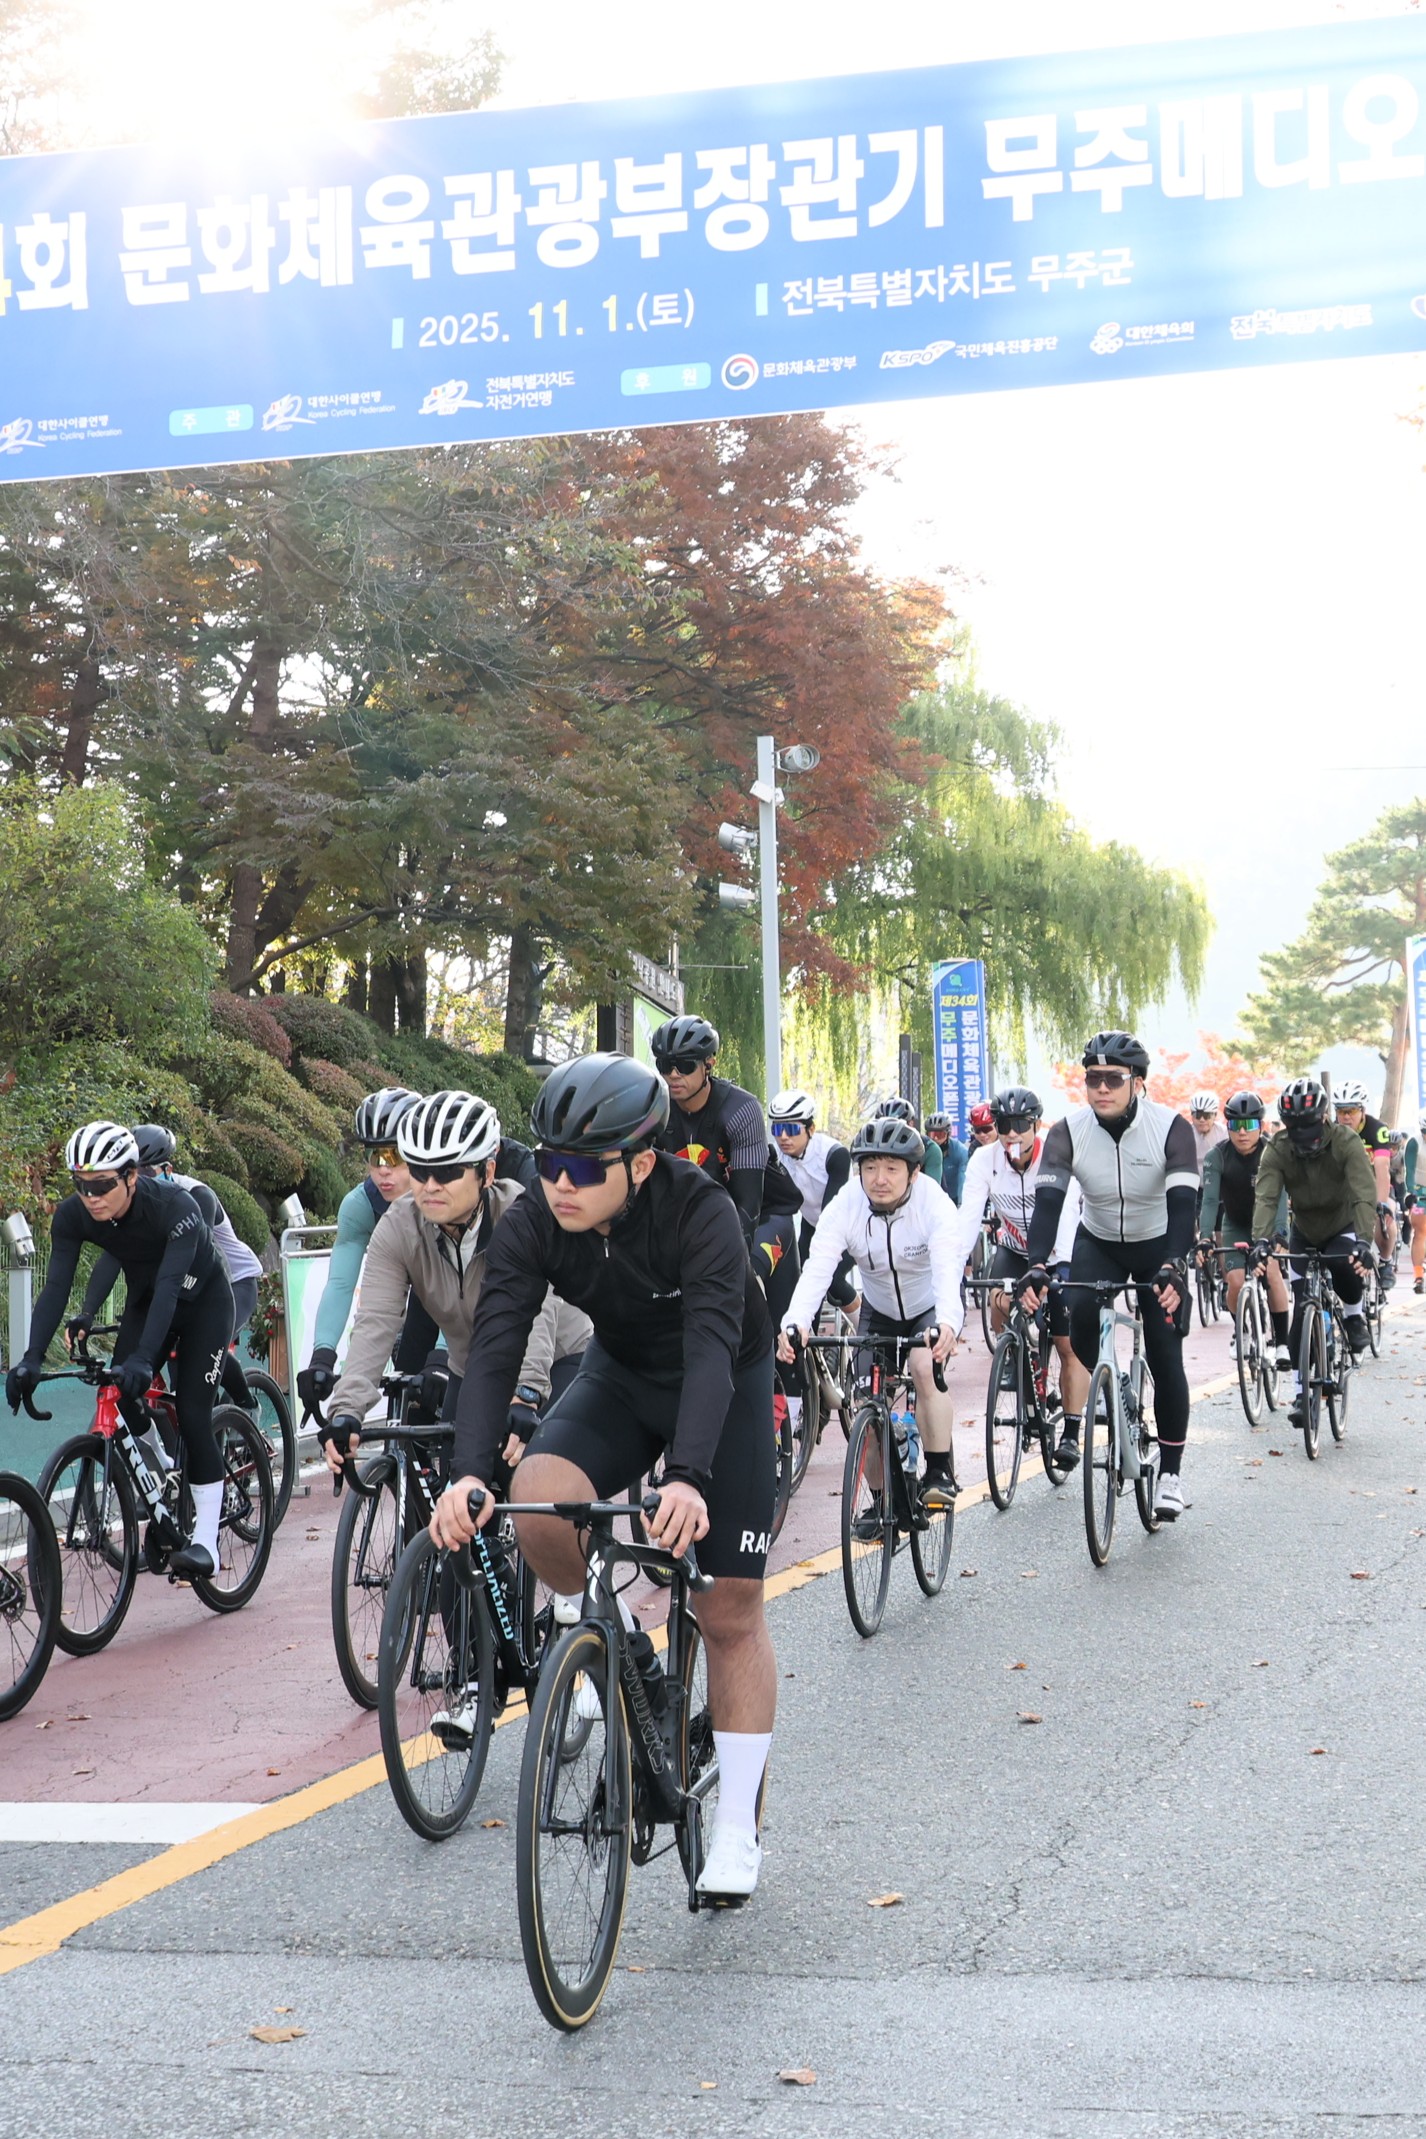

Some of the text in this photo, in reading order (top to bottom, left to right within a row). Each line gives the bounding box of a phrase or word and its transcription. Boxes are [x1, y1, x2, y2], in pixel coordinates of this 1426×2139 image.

[0, 73, 1426, 316] 회 문화체육관광부장관기 무주메디오
[781, 247, 1135, 317] 전북특별자치도 무주군
[418, 311, 511, 348] 2025.
[527, 299, 584, 339] 11.
[1125, 321, 1195, 340] 대한체육회
[880, 349, 935, 368] KSPO
[955, 335, 1059, 359] 국민체육진흥공단
[762, 355, 857, 378] 문화체육관광부
[486, 370, 576, 394] 전북특별자치도
[307, 391, 382, 409] 대한사이클연맹
[308, 403, 396, 420] Korea Cycling Federation
[486, 390, 553, 411] 자전거연맹
[37, 414, 110, 432] 대한사이클연맹
[60, 430, 85, 441] Cycling
[87, 427, 123, 439] Federation
[961, 1010, 982, 1138] 문화체육관광
[114, 1402, 171, 1525] TREK
